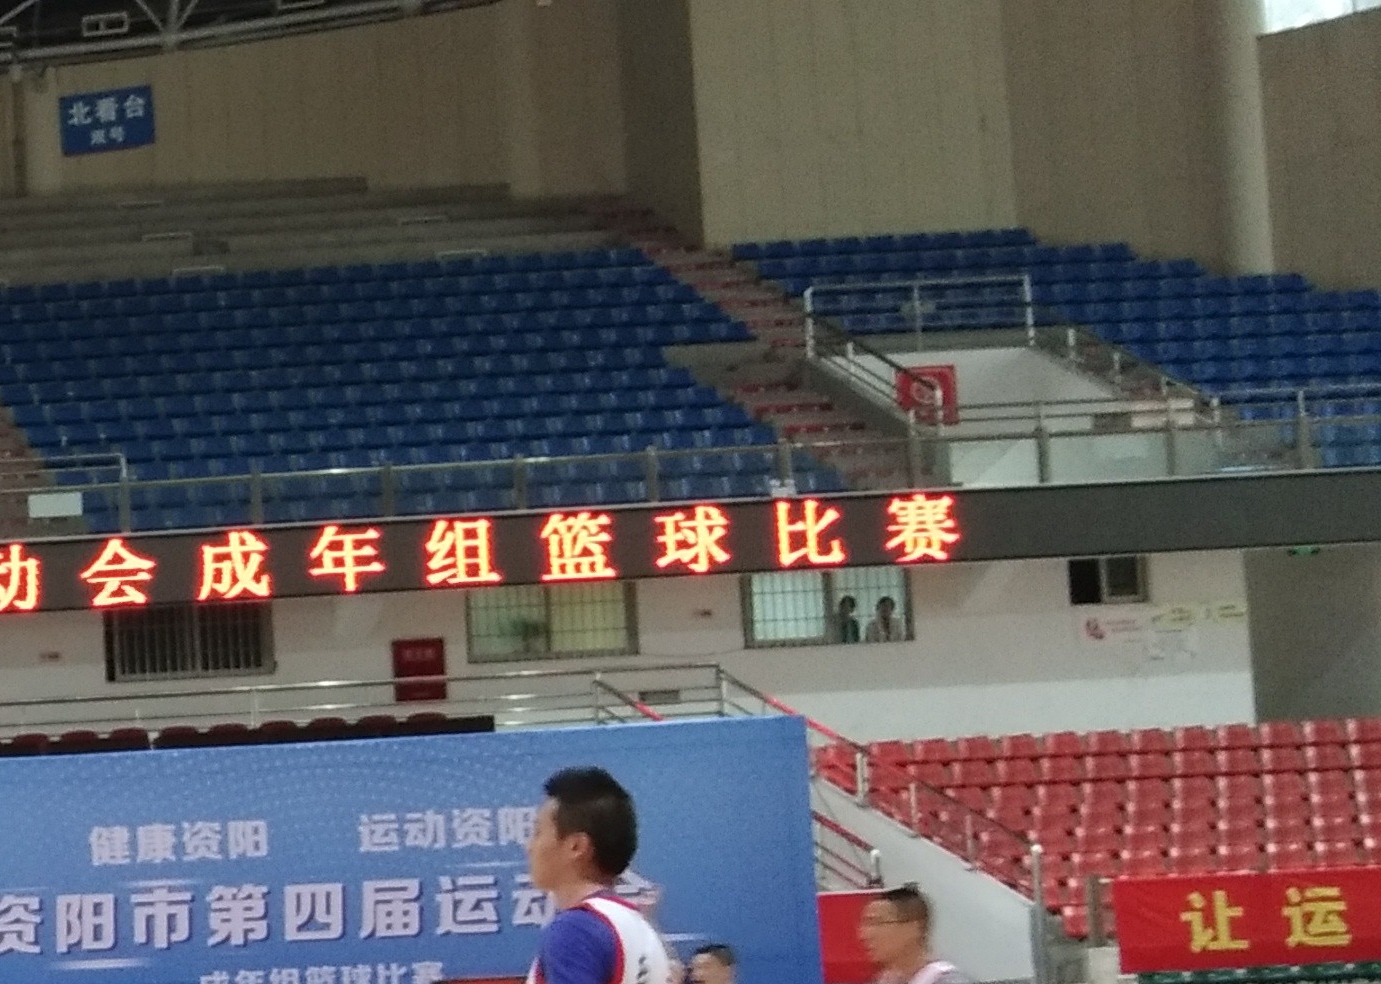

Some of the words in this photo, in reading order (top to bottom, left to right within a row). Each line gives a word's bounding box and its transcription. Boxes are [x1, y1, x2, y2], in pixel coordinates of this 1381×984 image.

[67, 93, 146, 126] 北看台
[90, 819, 269, 867] 健康资阳
[358, 806, 537, 853] 运动资阳
[1180, 887, 1353, 954] 让运
